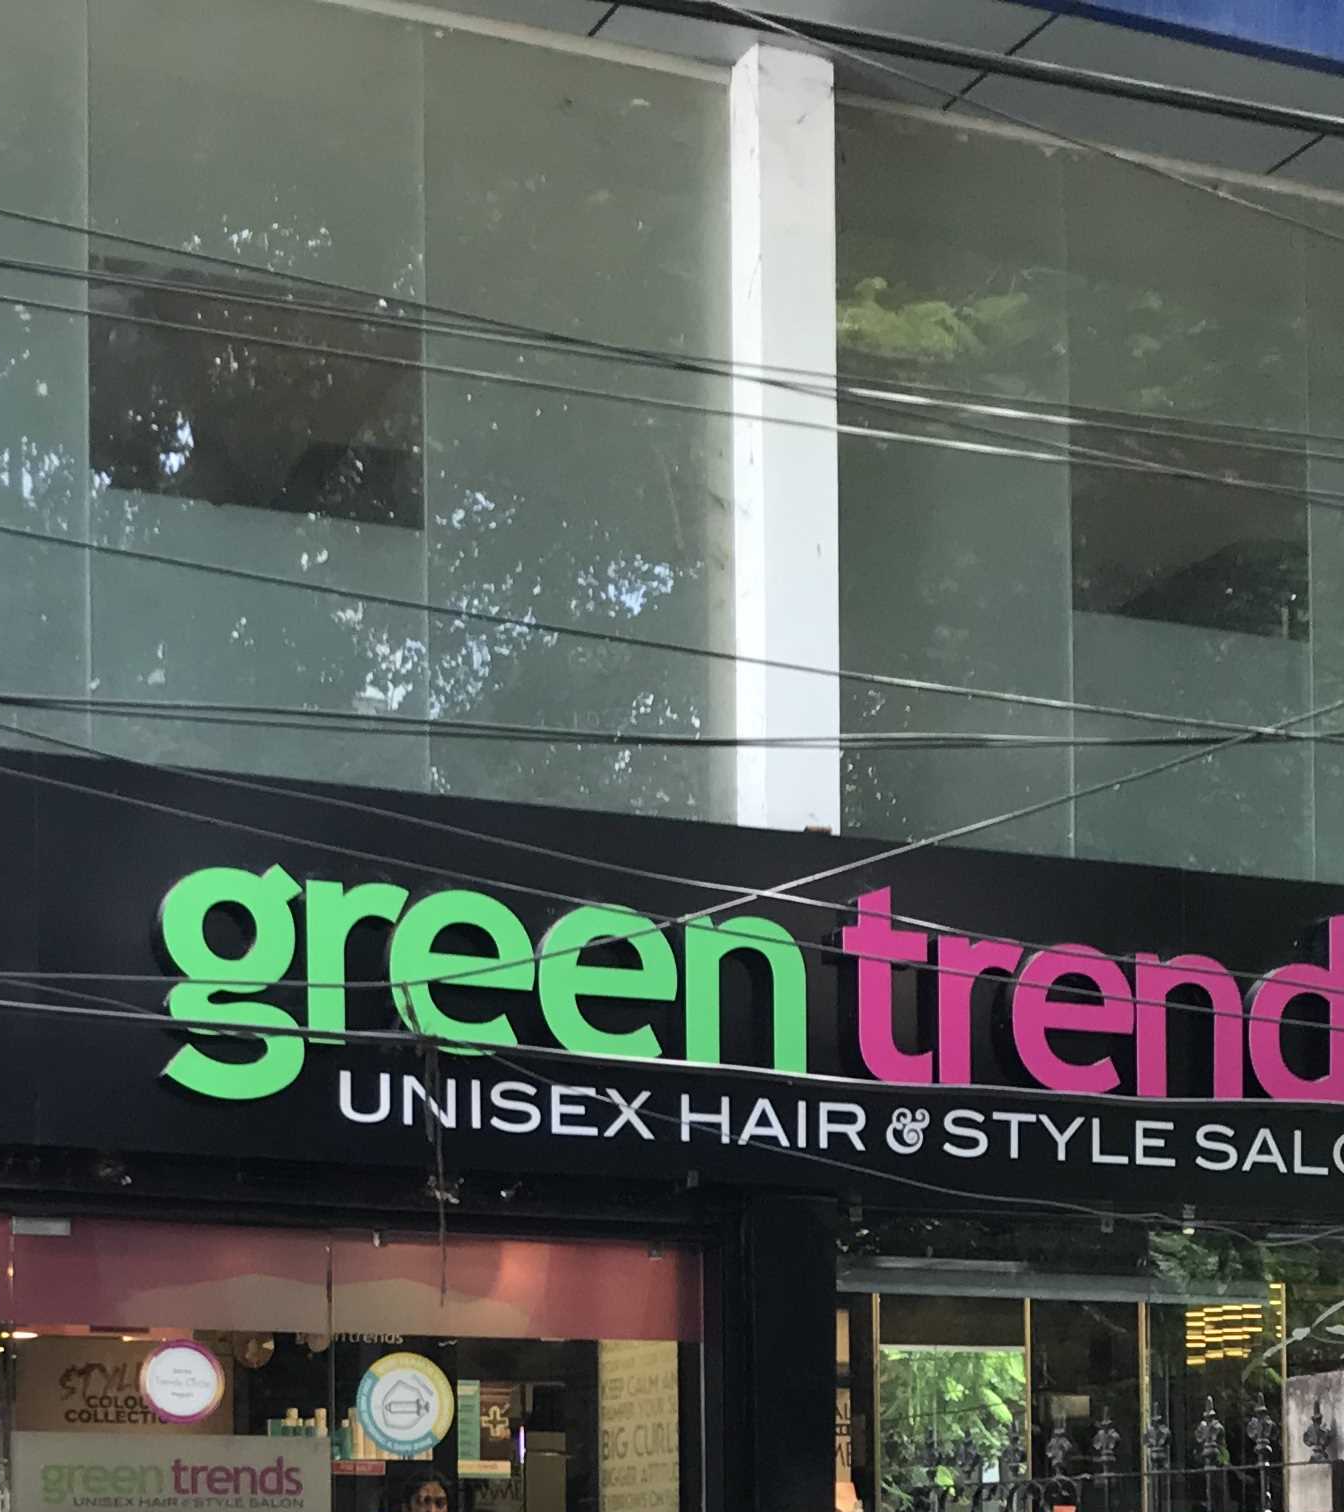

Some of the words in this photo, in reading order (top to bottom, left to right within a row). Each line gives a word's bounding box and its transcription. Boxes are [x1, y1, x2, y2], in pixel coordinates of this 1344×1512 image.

[162, 864, 808, 1100] green
[339, 1069, 655, 1141] UNISEX
[680, 1094, 867, 1152] HAIR
[885, 1106, 930, 1155] &
[942, 1109, 1177, 1168] STYLE
[65, 1409, 168, 1424] COLLECTI
[86, 1395, 149, 1409] COLOU
[40, 1464, 164, 1503] green
[171, 1456, 304, 1497] trends
[72, 1496, 135, 1508] UNISEX
[138, 1496, 178, 1508] HAIR
[192, 1496, 244, 1508] STYLE
[249, 1496, 305, 1509] SALON
